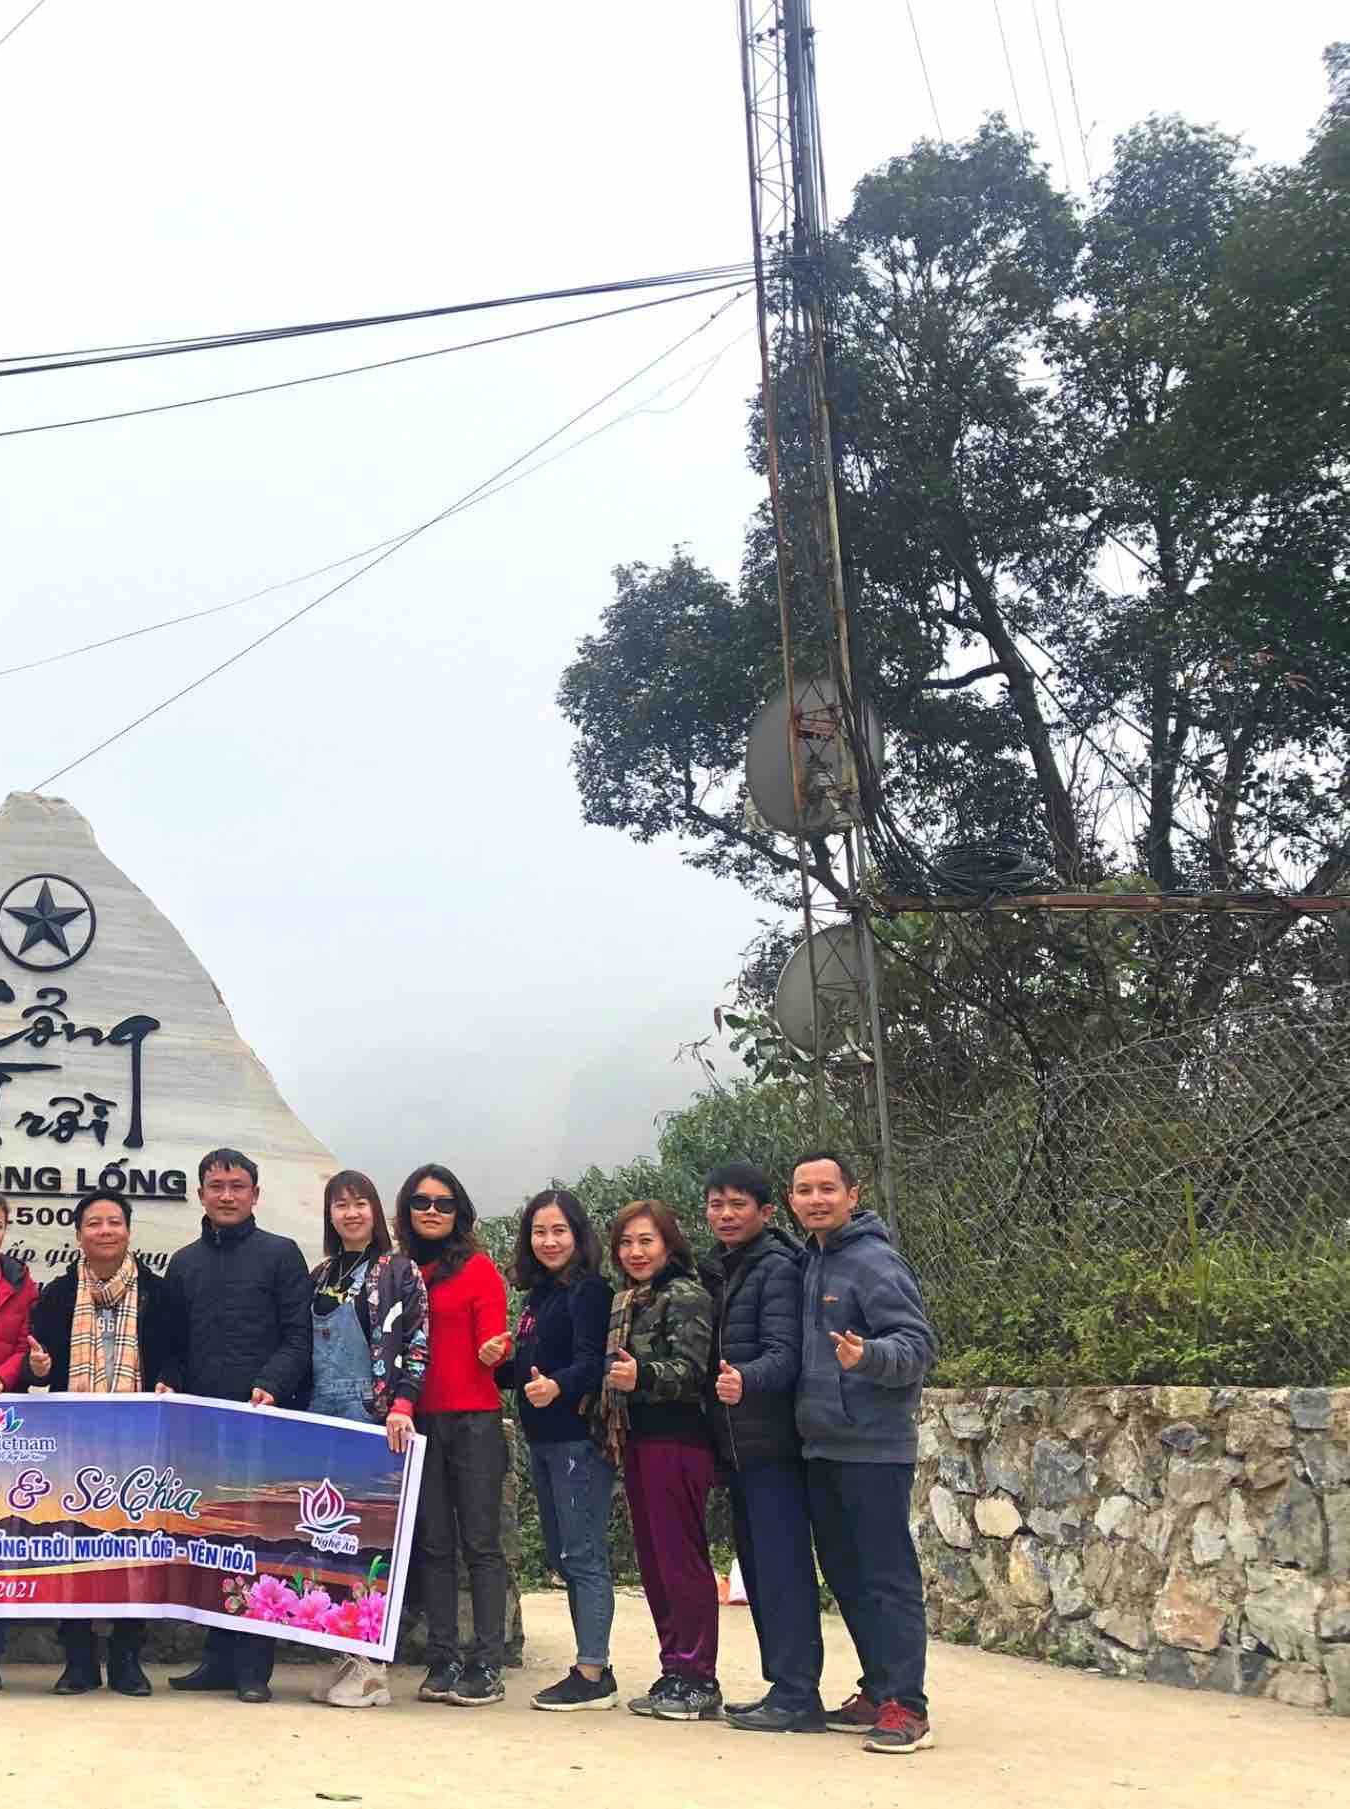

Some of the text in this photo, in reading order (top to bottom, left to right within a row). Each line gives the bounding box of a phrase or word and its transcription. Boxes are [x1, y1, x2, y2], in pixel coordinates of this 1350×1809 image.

[76, 1157, 187, 1195] LỐNG
[9, 1469, 50, 1510] &
[118, 1466, 202, 1522] Chia
[30, 1535, 70, 1559] TRỜI
[74, 1534, 138, 1559] MƯỜNG
[189, 1540, 219, 1566] YÊN
[221, 1545, 255, 1573] HÒA
